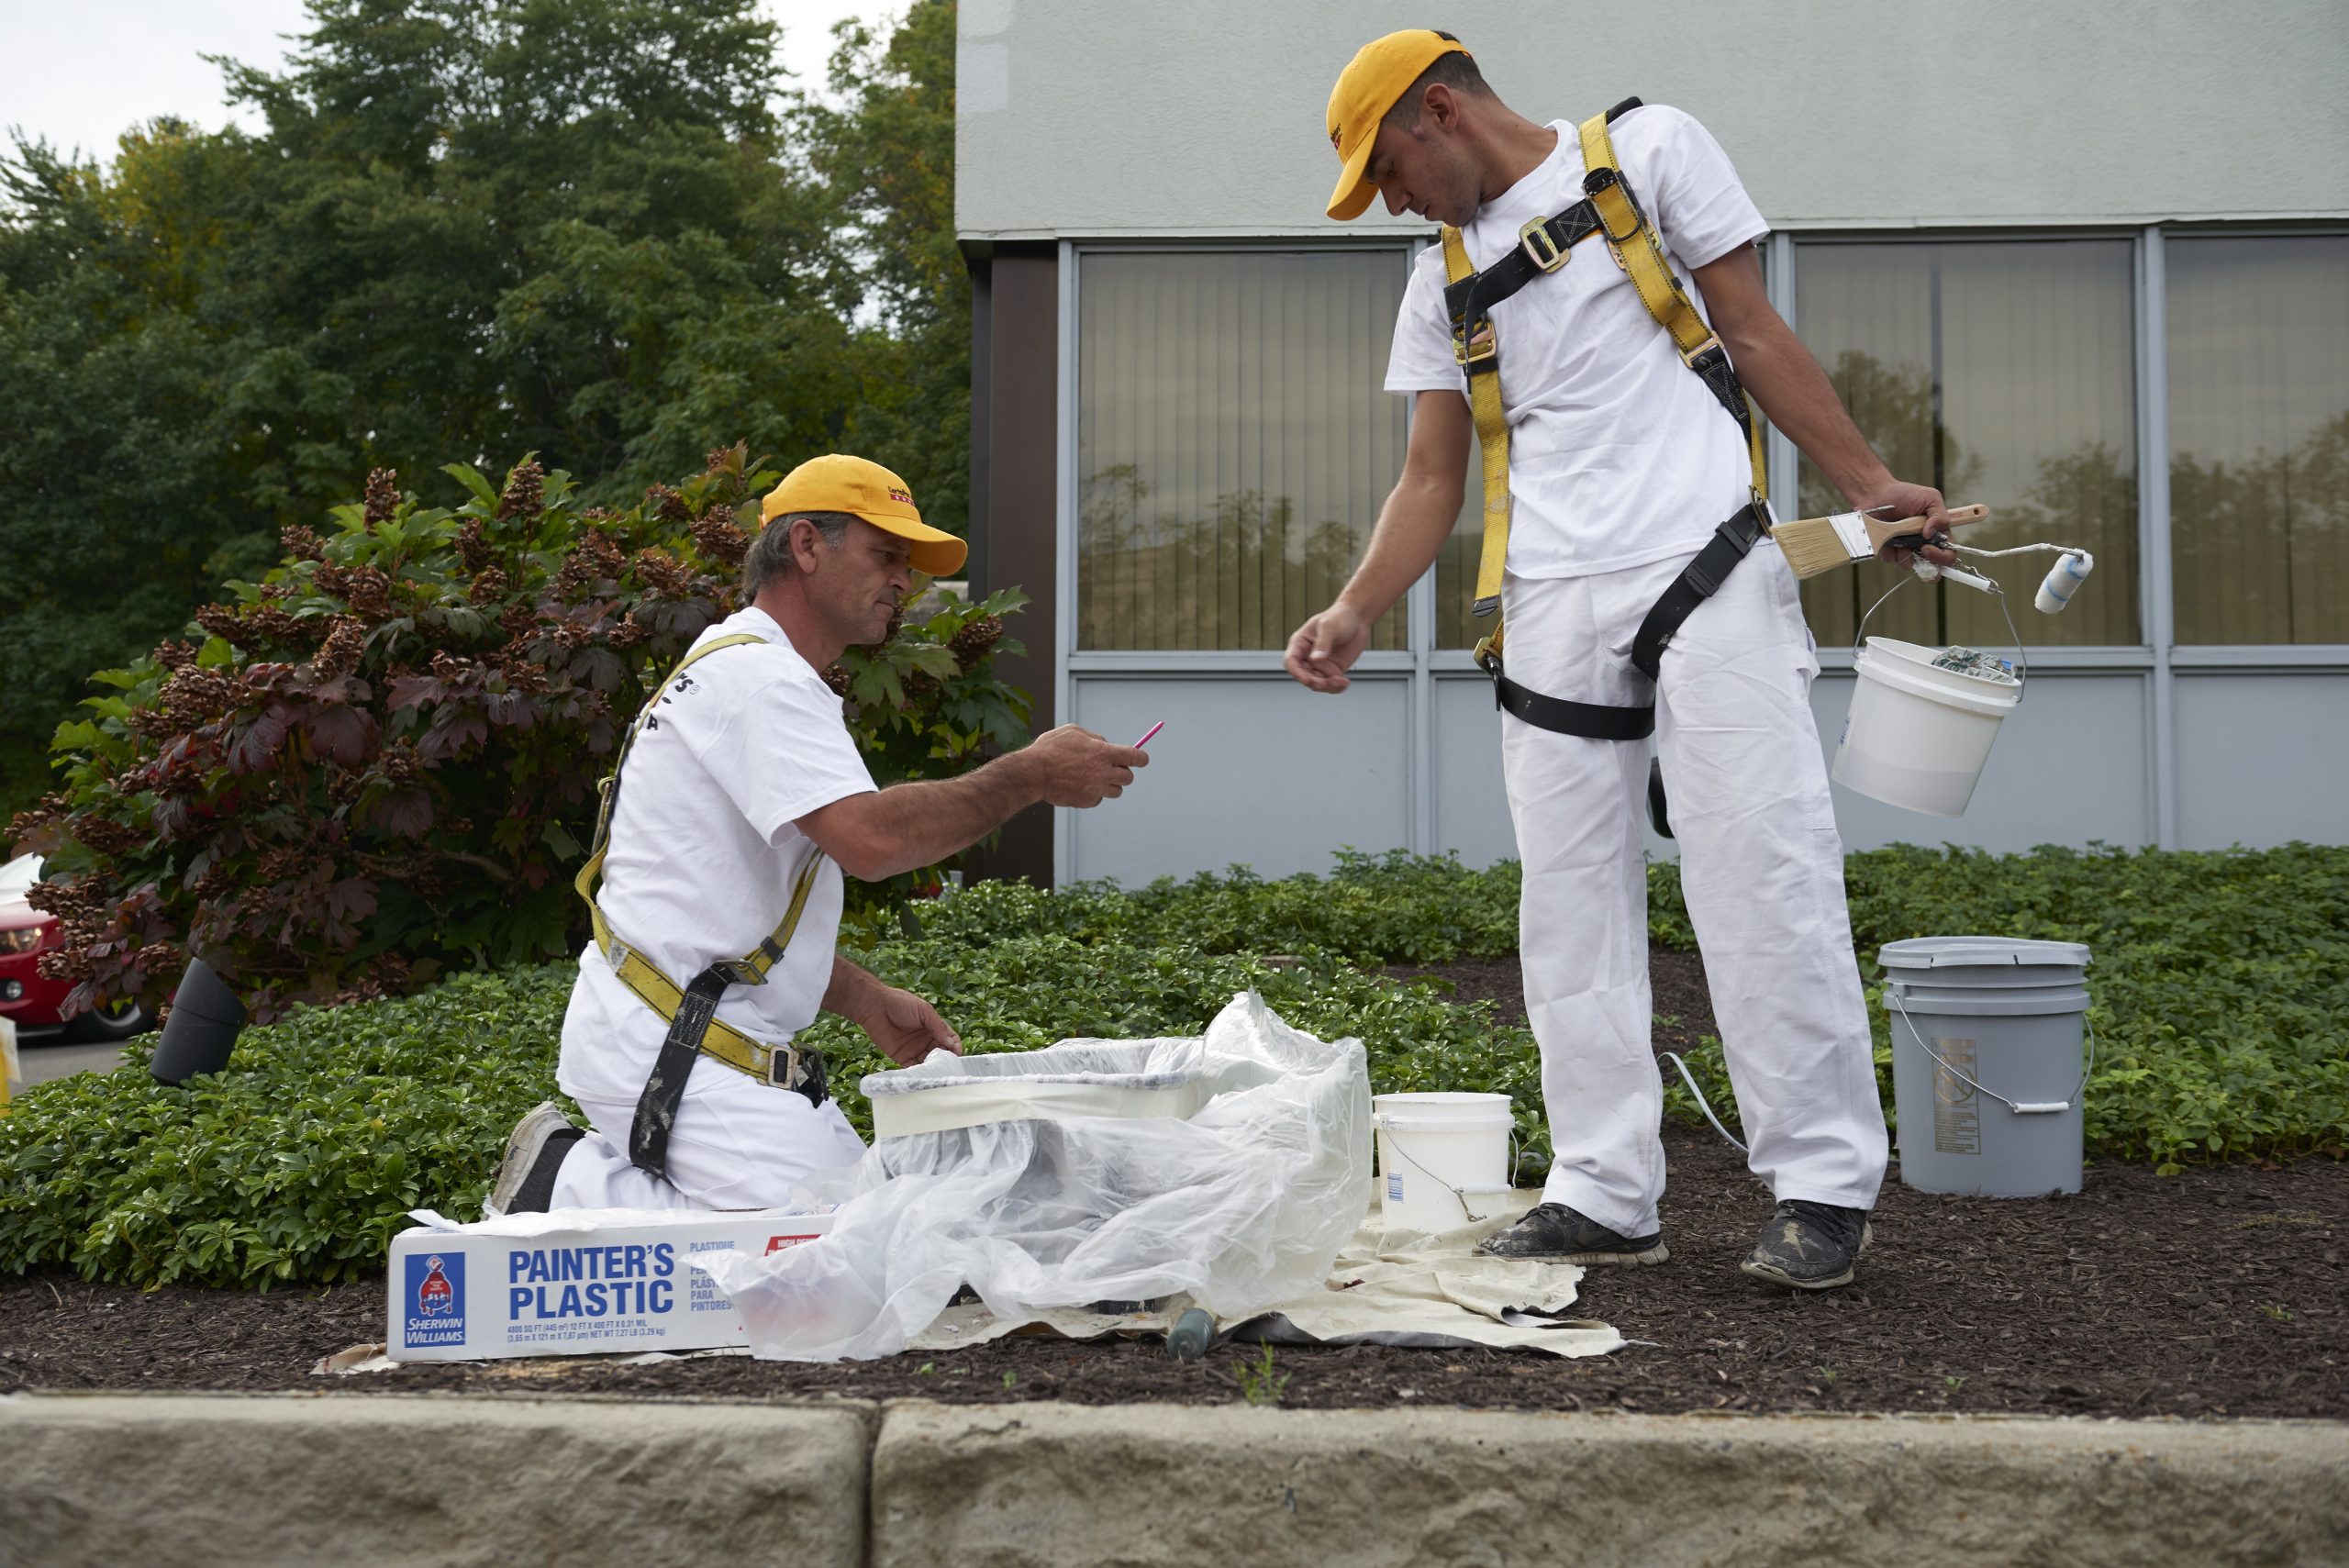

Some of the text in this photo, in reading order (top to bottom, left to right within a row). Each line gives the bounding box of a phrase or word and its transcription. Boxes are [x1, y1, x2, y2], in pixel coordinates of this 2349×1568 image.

[690, 1240, 735, 1252] PLASTIQUE
[509, 1243, 674, 1284] PAINTER'S
[690, 1276, 719, 1289] PLÁST
[509, 1279, 674, 1320] PLASTIC
[690, 1290, 714, 1301] PARA
[690, 1300, 732, 1312] PINTORES
[407, 1318, 463, 1330] SHERWIN
[524, 1325, 532, 1333] SQ
[534, 1324, 542, 1332] FT
[543, 1323, 557, 1332] (445
[571, 1322, 577, 1330] 12
[579, 1322, 586, 1330] FT
[538, 1333, 548, 1341] 121
[590, 1330, 602, 1339] NET
[604, 1329, 614, 1338] WT
[629, 1328, 638, 1336] LB
[656, 1327, 666, 1336] kg)
